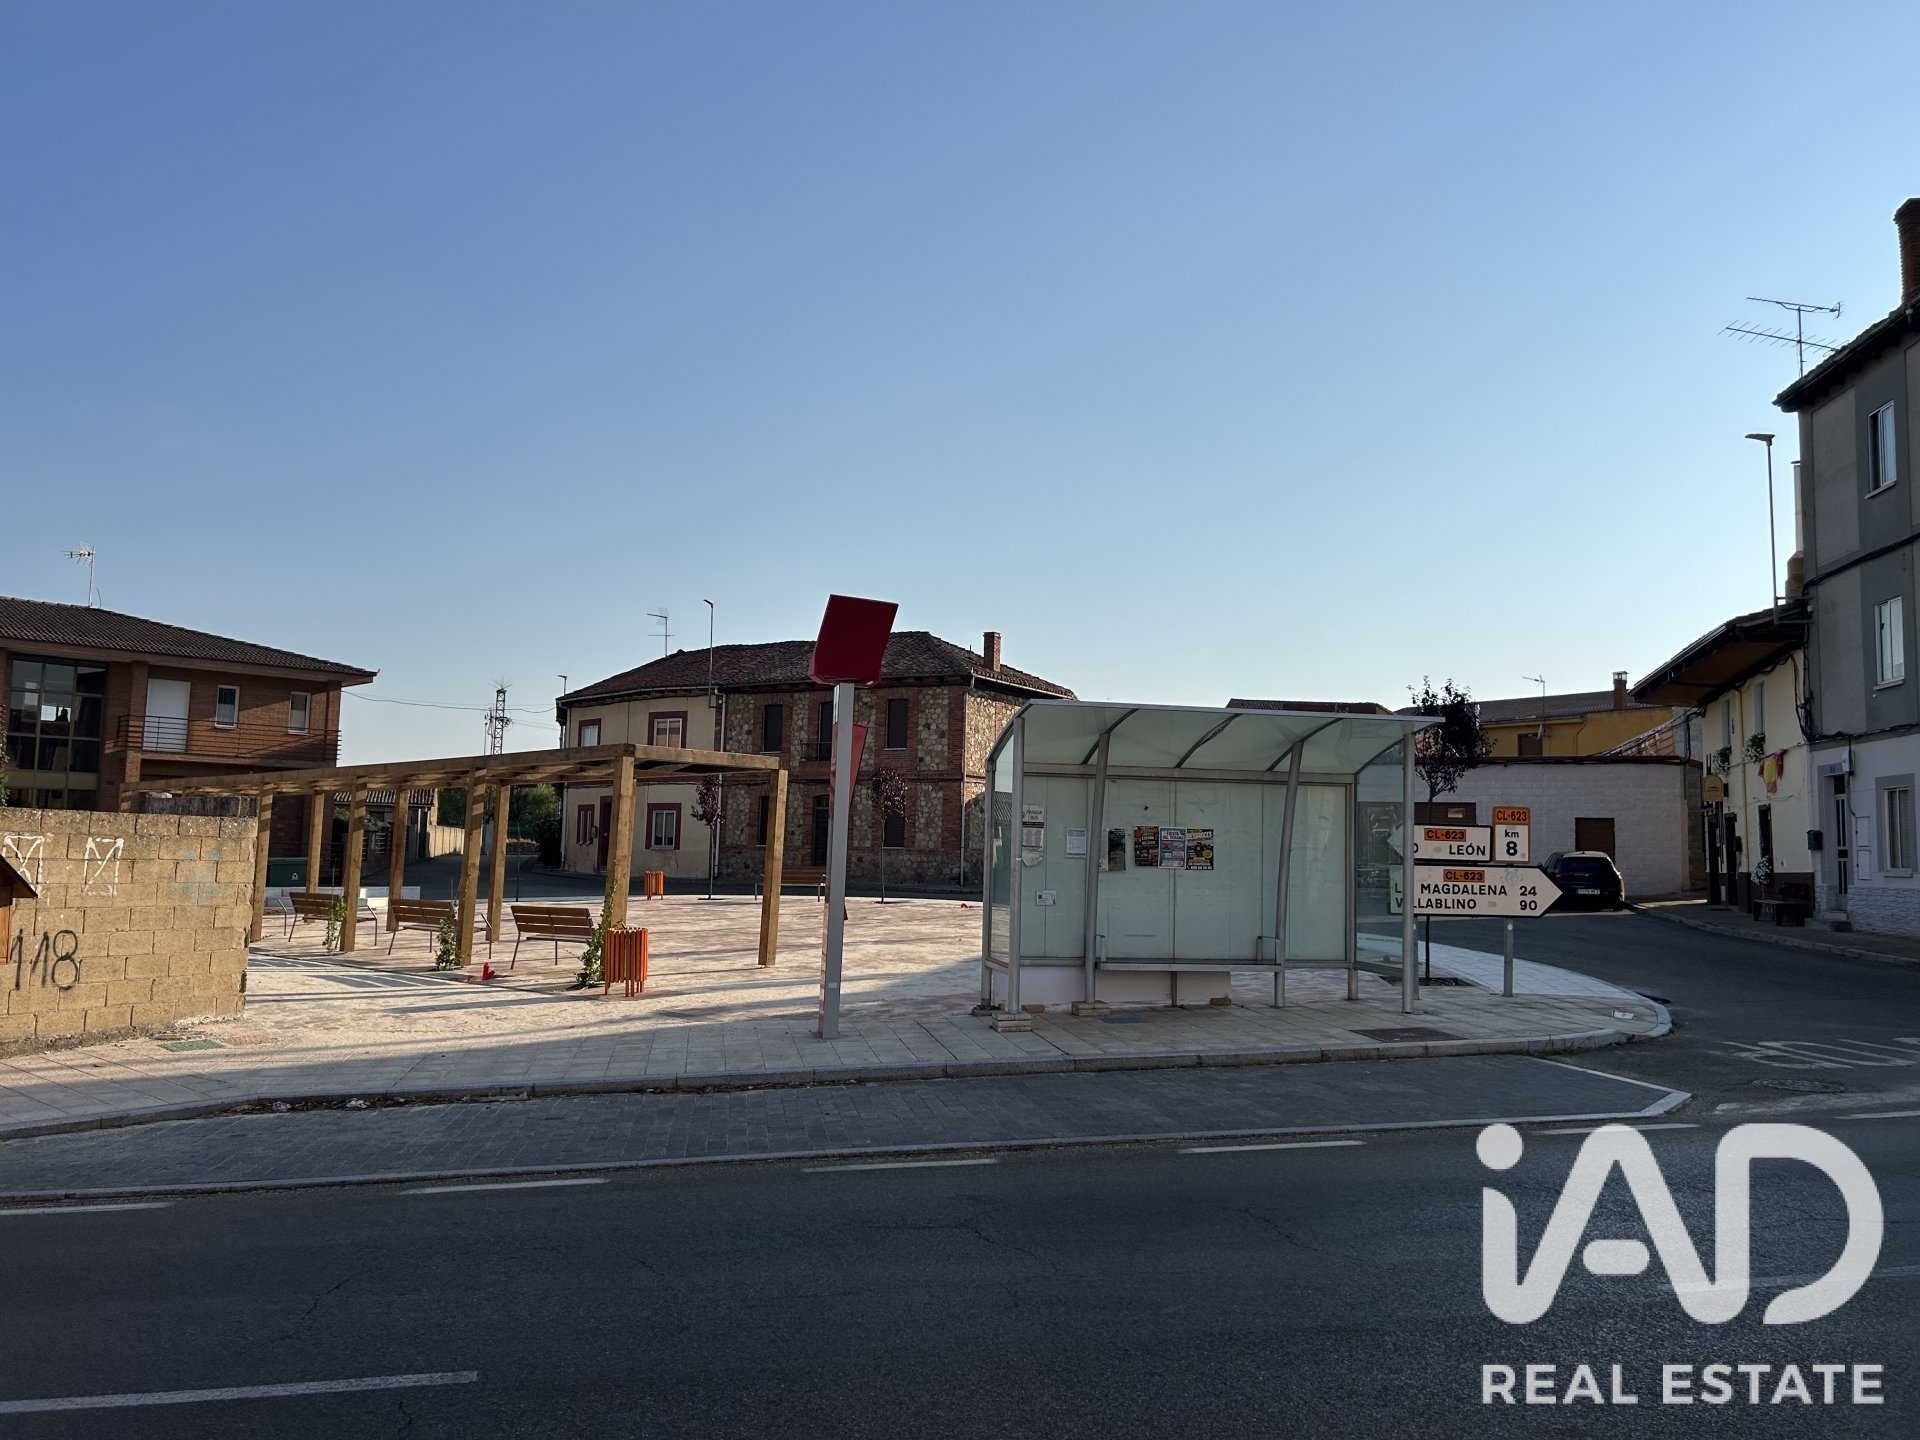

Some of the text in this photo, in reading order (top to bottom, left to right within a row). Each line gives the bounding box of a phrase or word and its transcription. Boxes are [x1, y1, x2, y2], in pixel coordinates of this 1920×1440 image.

[1497, 810, 1527, 821] CL-623
[1426, 829, 1465, 840] CL-623
[1505, 829, 1519, 838] km
[1449, 842, 1486, 856] LEÓN
[1506, 841, 1518, 856] 8
[1445, 871, 1484, 881] CL-623
[1420, 883, 1508, 896] MAGDALENA
[1519, 886, 1537, 896] 24
[1395, 898, 1538, 911] VLABLINO 90
